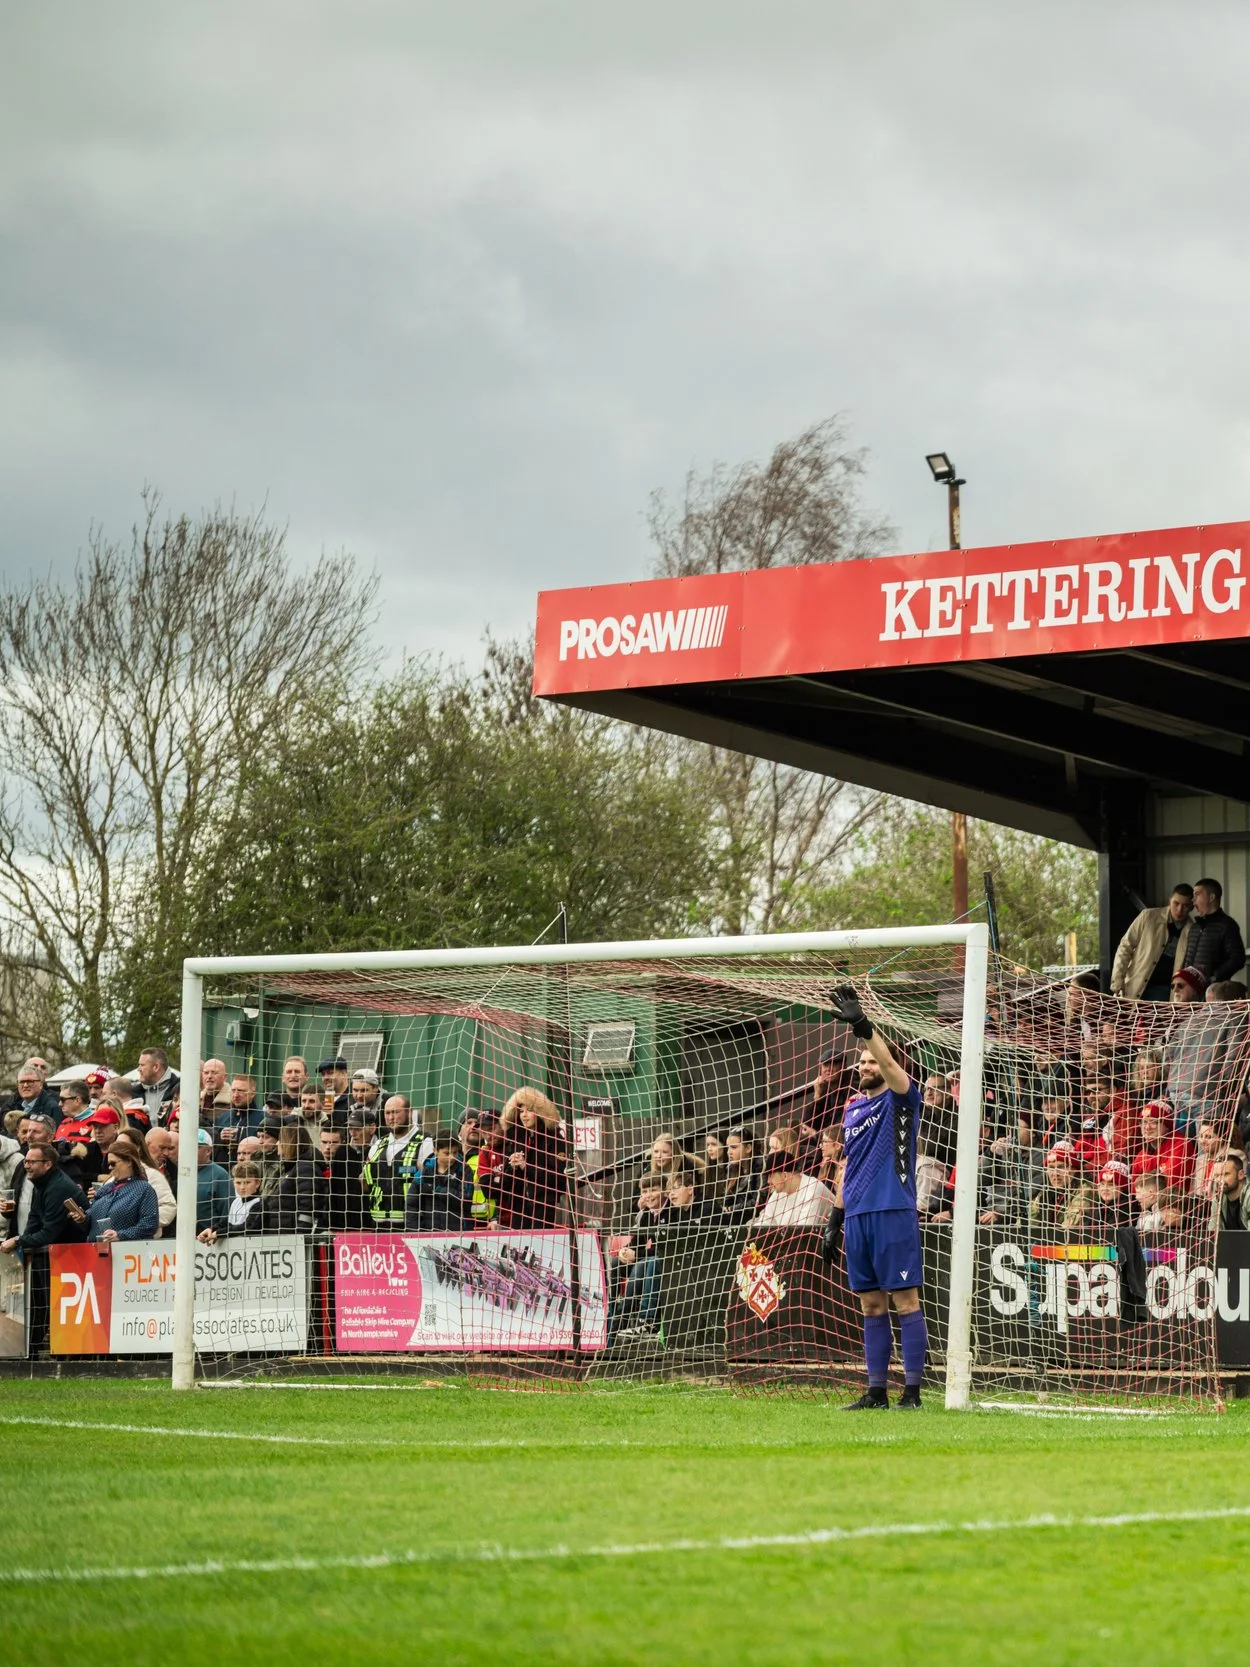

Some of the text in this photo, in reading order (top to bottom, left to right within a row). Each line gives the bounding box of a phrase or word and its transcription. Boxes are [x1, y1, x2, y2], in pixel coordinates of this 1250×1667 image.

[879, 549, 1246, 642] KETTERING
[559, 609, 689, 662] PROSAW
[194, 1250, 293, 1282] SSOCIATES
[339, 1244, 408, 1287] Bailey's
[60, 1272, 101, 1325] PA
[124, 1289, 159, 1303] SOURCE
[210, 1287, 242, 1301] DESIGN
[255, 1285, 293, 1300] DEVELOP
[341, 1289, 355, 1297] SKIP
[356, 1289, 370, 1297] HIRE
[364, 1318, 378, 1328] Skip
[378, 1318, 390, 1326] Hire
[390, 1318, 415, 1328] Company
[418, 1331, 433, 1340] Scan
[435, 1332, 441, 1340] to
[441, 1331, 456, 1340] visit
[457, 1332, 469, 1340] our
[470, 1331, 496, 1340] website
